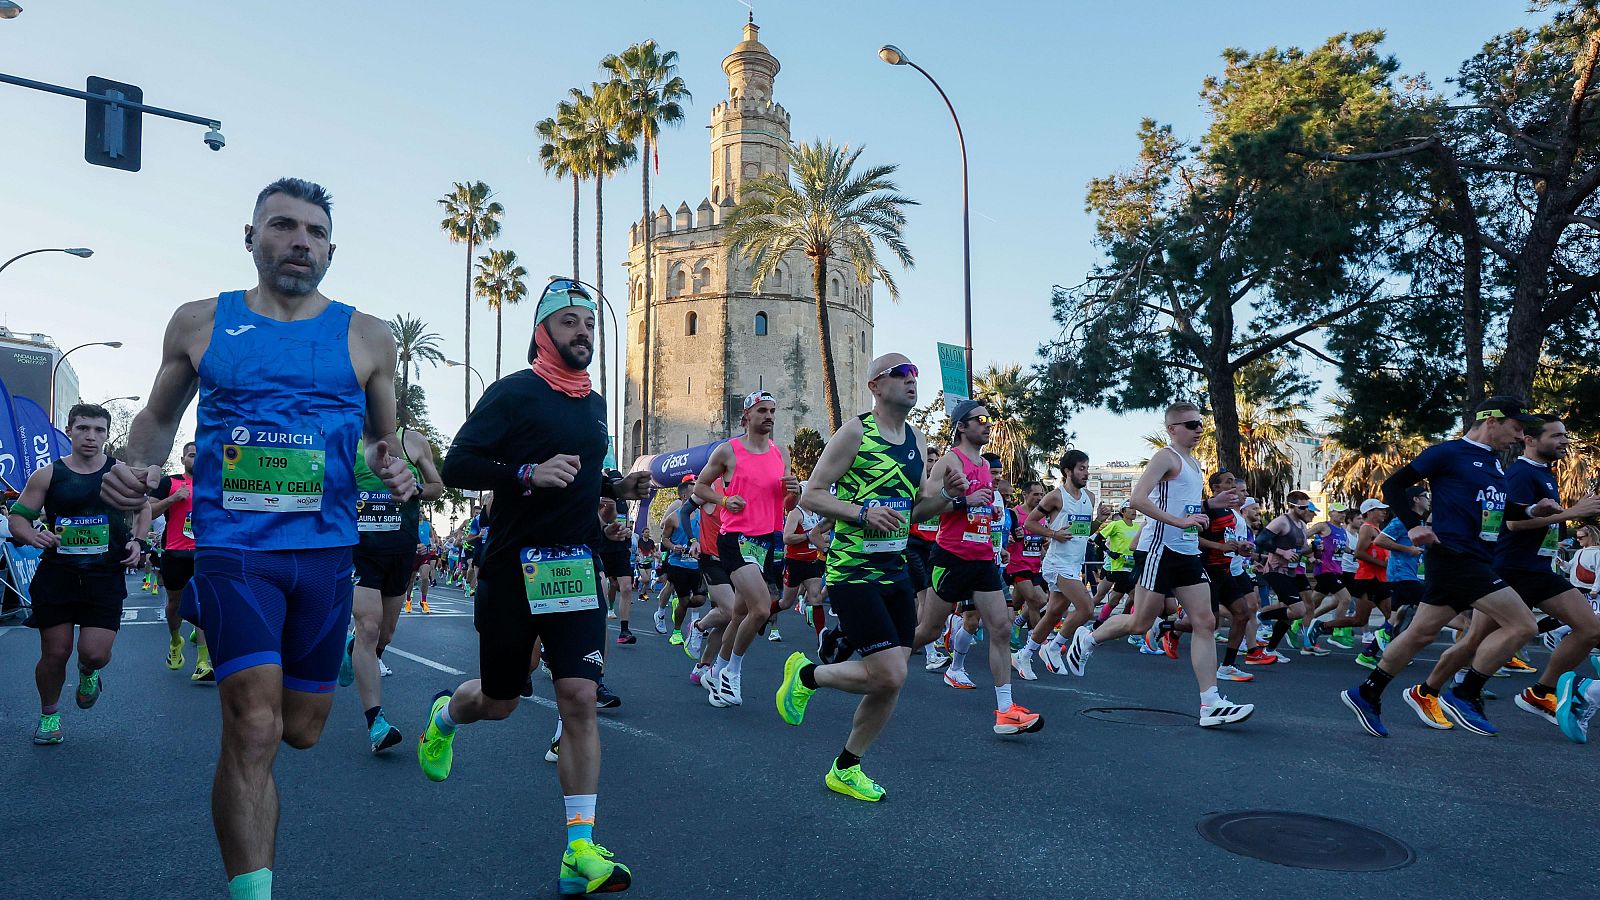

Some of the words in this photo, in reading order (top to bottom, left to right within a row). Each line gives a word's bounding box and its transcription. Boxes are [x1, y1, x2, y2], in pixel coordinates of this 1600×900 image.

[940, 346, 963, 362] SALÓN
[256, 431, 313, 445] ZURICH
[258, 456, 288, 469] 1799
[223, 478, 272, 492] ANDREA
[274, 481, 284, 492] Y
[287, 481, 323, 493] CELIA
[67, 536, 100, 545] LUKAS
[547, 548, 584, 559] ZURCH
[551, 568, 571, 577] 1805
[541, 580, 583, 596] MATEO
